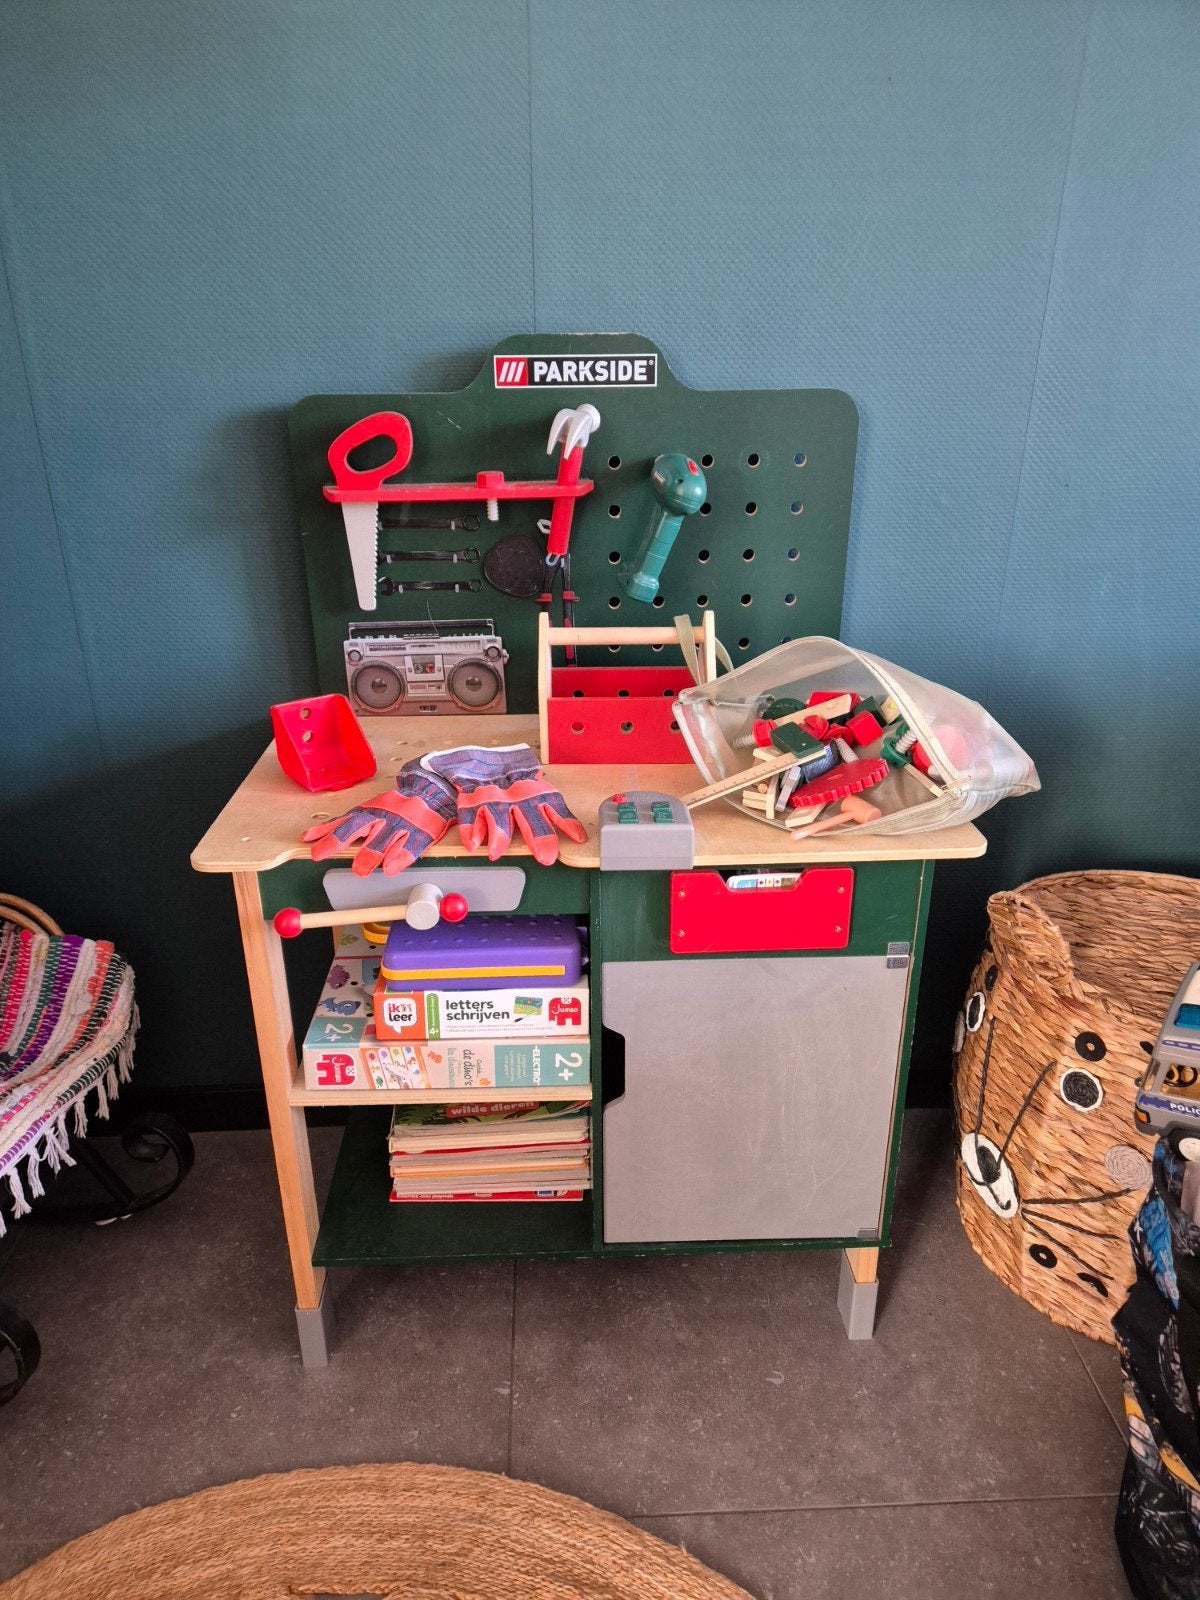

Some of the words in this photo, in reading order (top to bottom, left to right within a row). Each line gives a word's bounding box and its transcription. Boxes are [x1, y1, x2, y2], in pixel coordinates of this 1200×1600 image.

[533, 359, 648, 382] PARKSIDE
[388, 1003, 400, 1012] ik
[446, 999, 494, 1010] letters
[388, 1012, 413, 1022] leer
[446, 1009, 510, 1023] schrijven
[324, 1023, 354, 1042] 2+
[463, 1049, 475, 1060] de
[532, 1048, 541, 1085] ELECTRO
[554, 1052, 582, 1081] 2+
[462, 1061, 474, 1087] dino's
[451, 1105, 488, 1115] wilde
[490, 1101, 534, 1112] dieren
